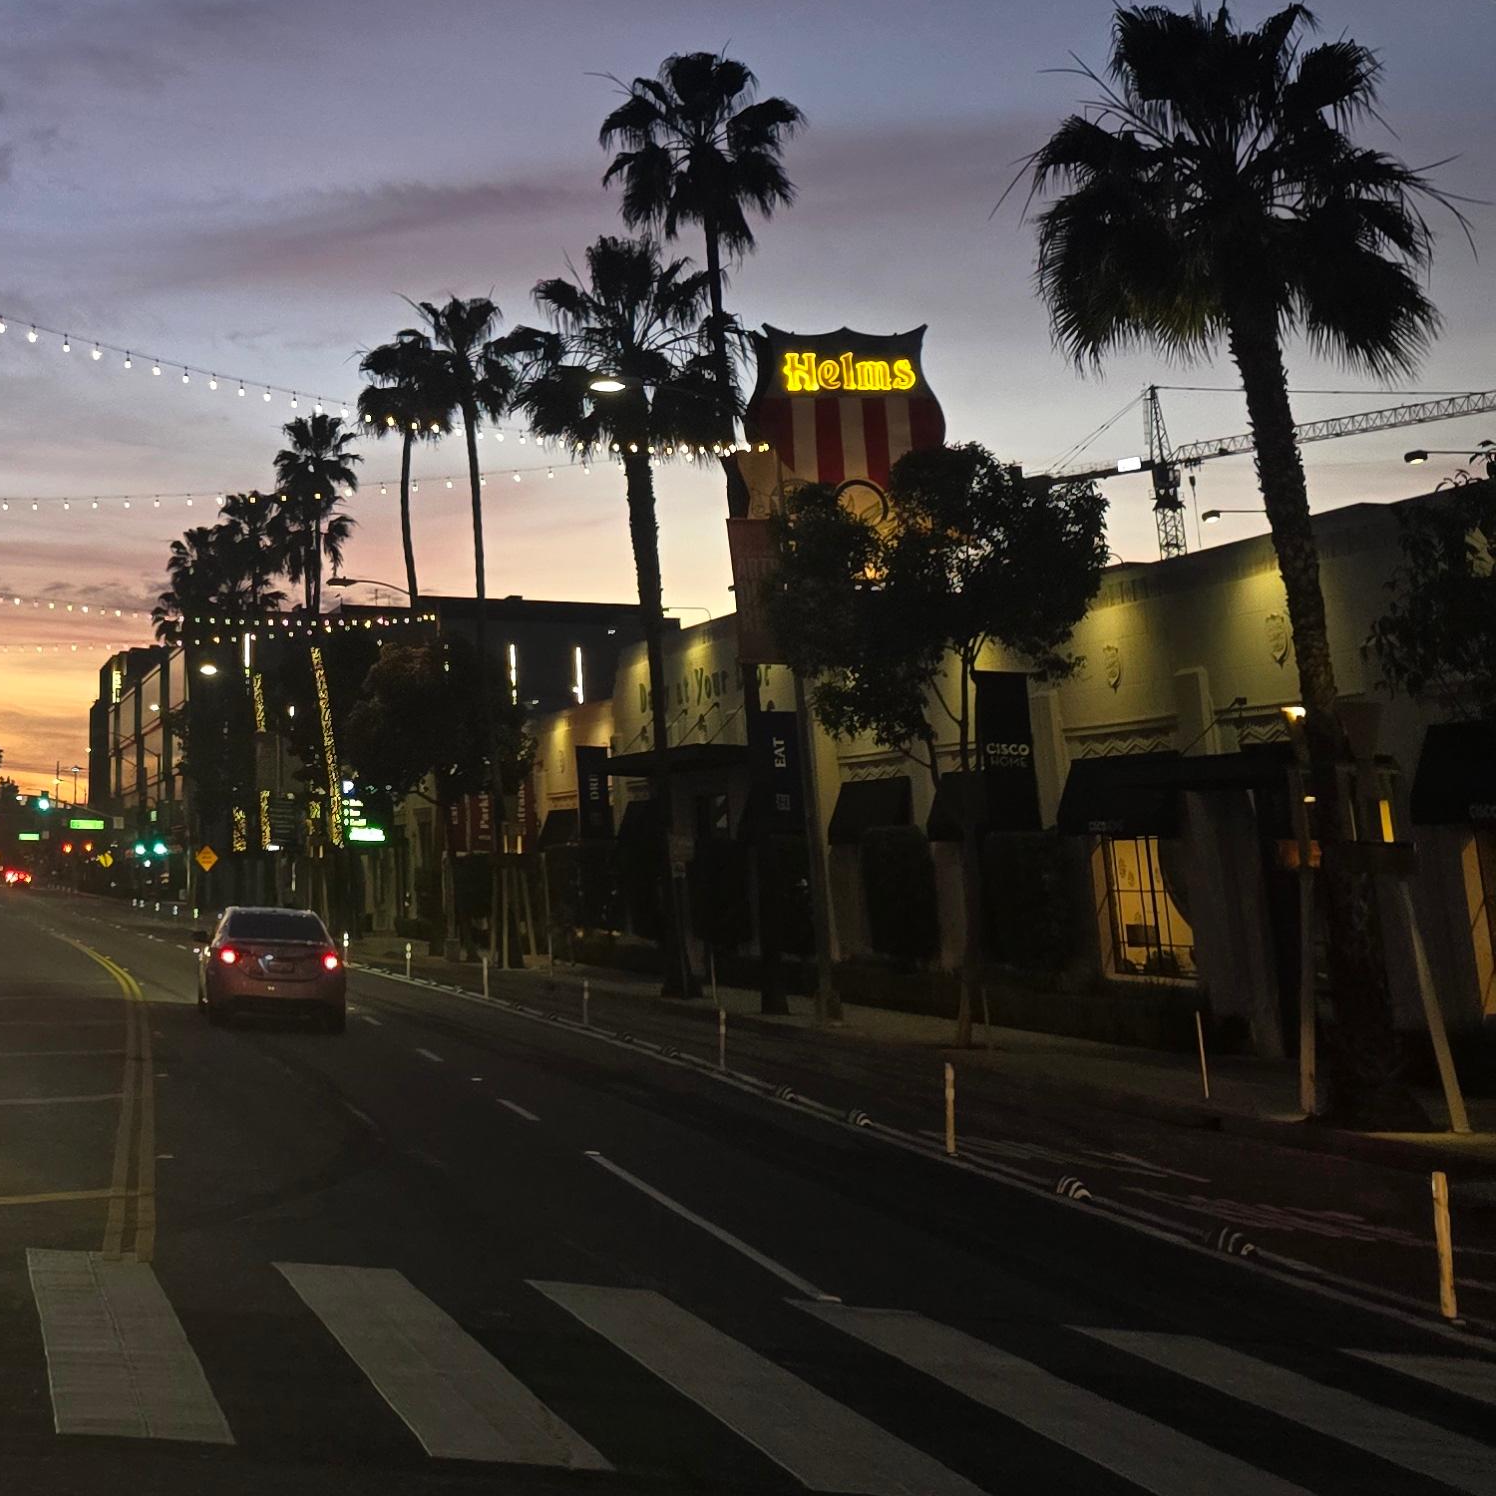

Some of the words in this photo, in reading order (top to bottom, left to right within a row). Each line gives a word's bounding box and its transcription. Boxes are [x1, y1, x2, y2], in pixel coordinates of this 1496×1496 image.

[783, 351, 917, 392] Helms
[772, 736, 787, 768] EAT
[986, 742, 1030, 756] CISCO
[990, 756, 1028, 768] HOME
